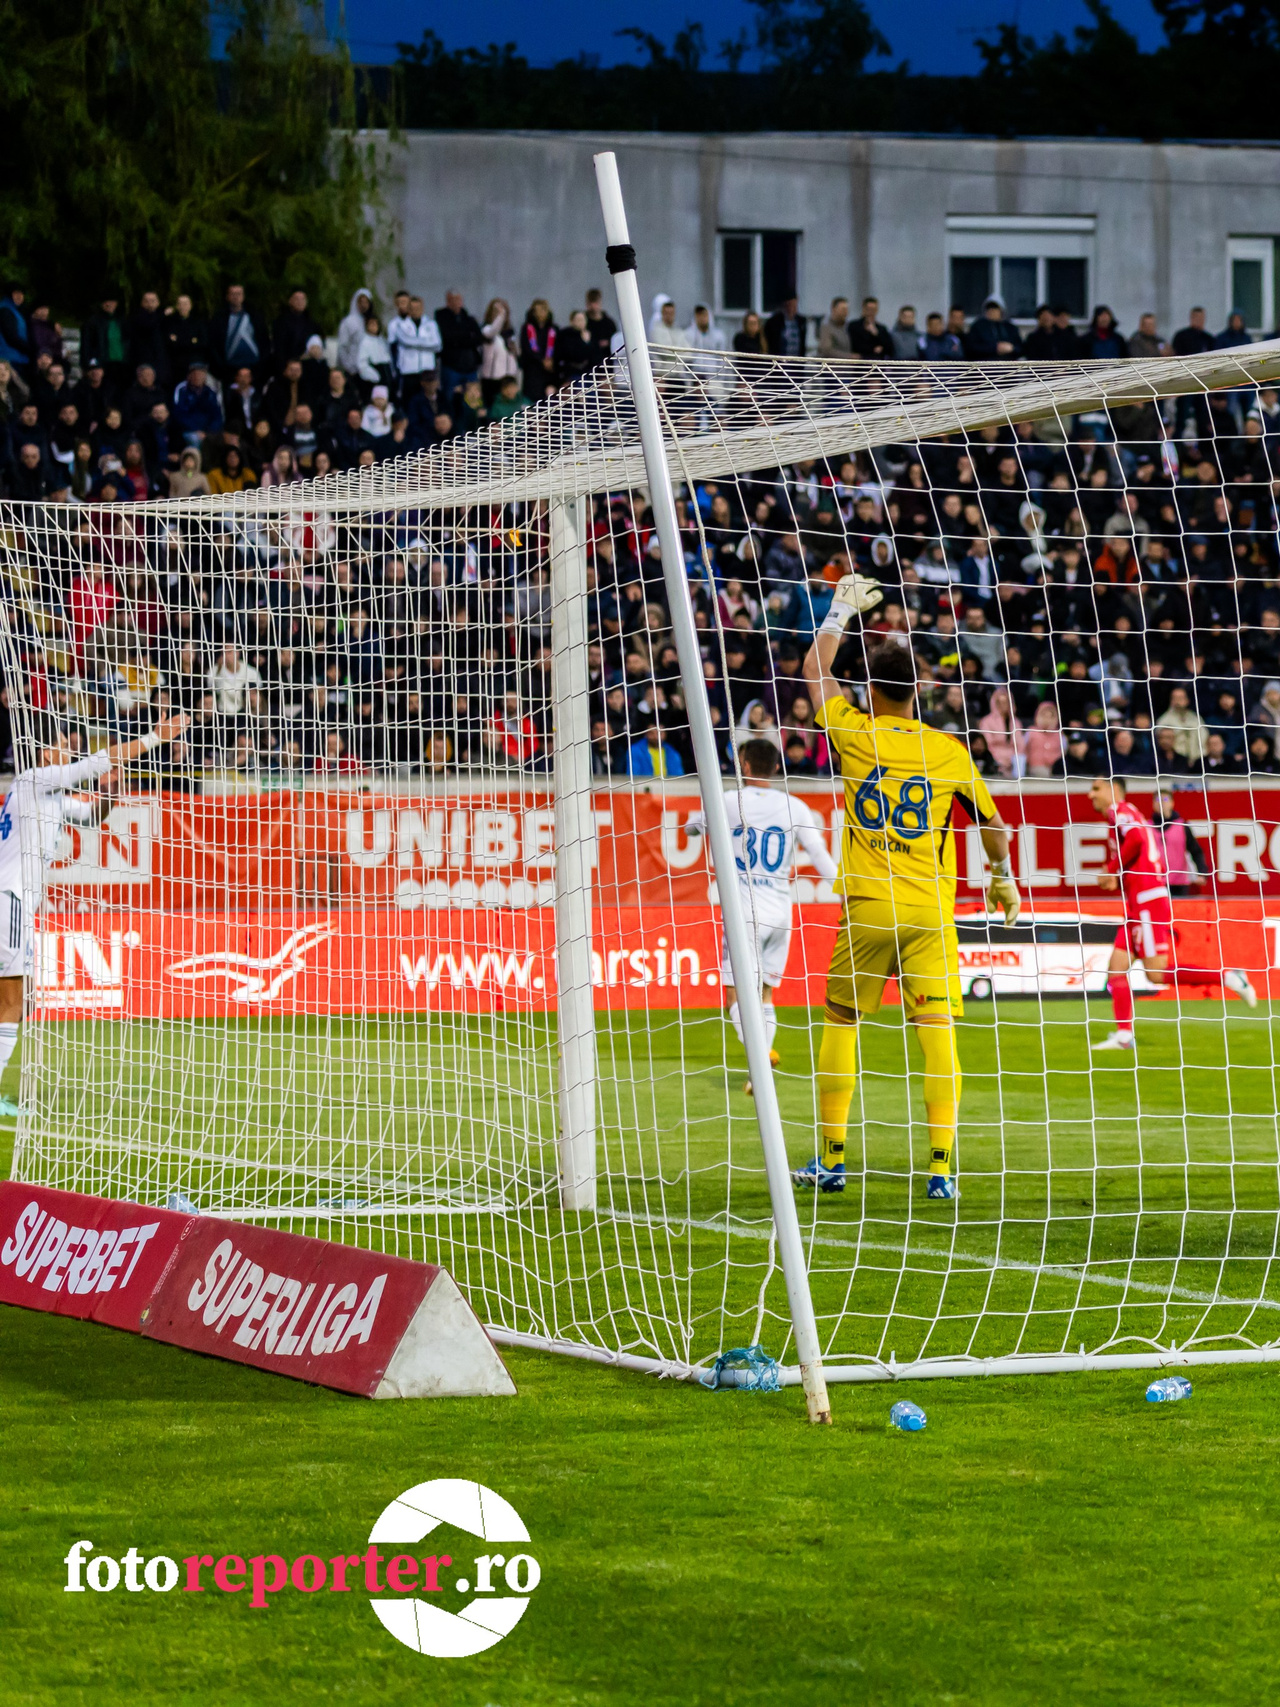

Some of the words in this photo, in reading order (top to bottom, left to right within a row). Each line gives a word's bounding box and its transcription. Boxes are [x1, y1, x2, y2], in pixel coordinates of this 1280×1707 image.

[854, 764, 933, 840] 68
[733, 824, 786, 873] 30
[870, 839, 911, 855] DUCAN
[1, 1200, 161, 1296] SUPERBET
[187, 1237, 388, 1357] SUPERLIGA
